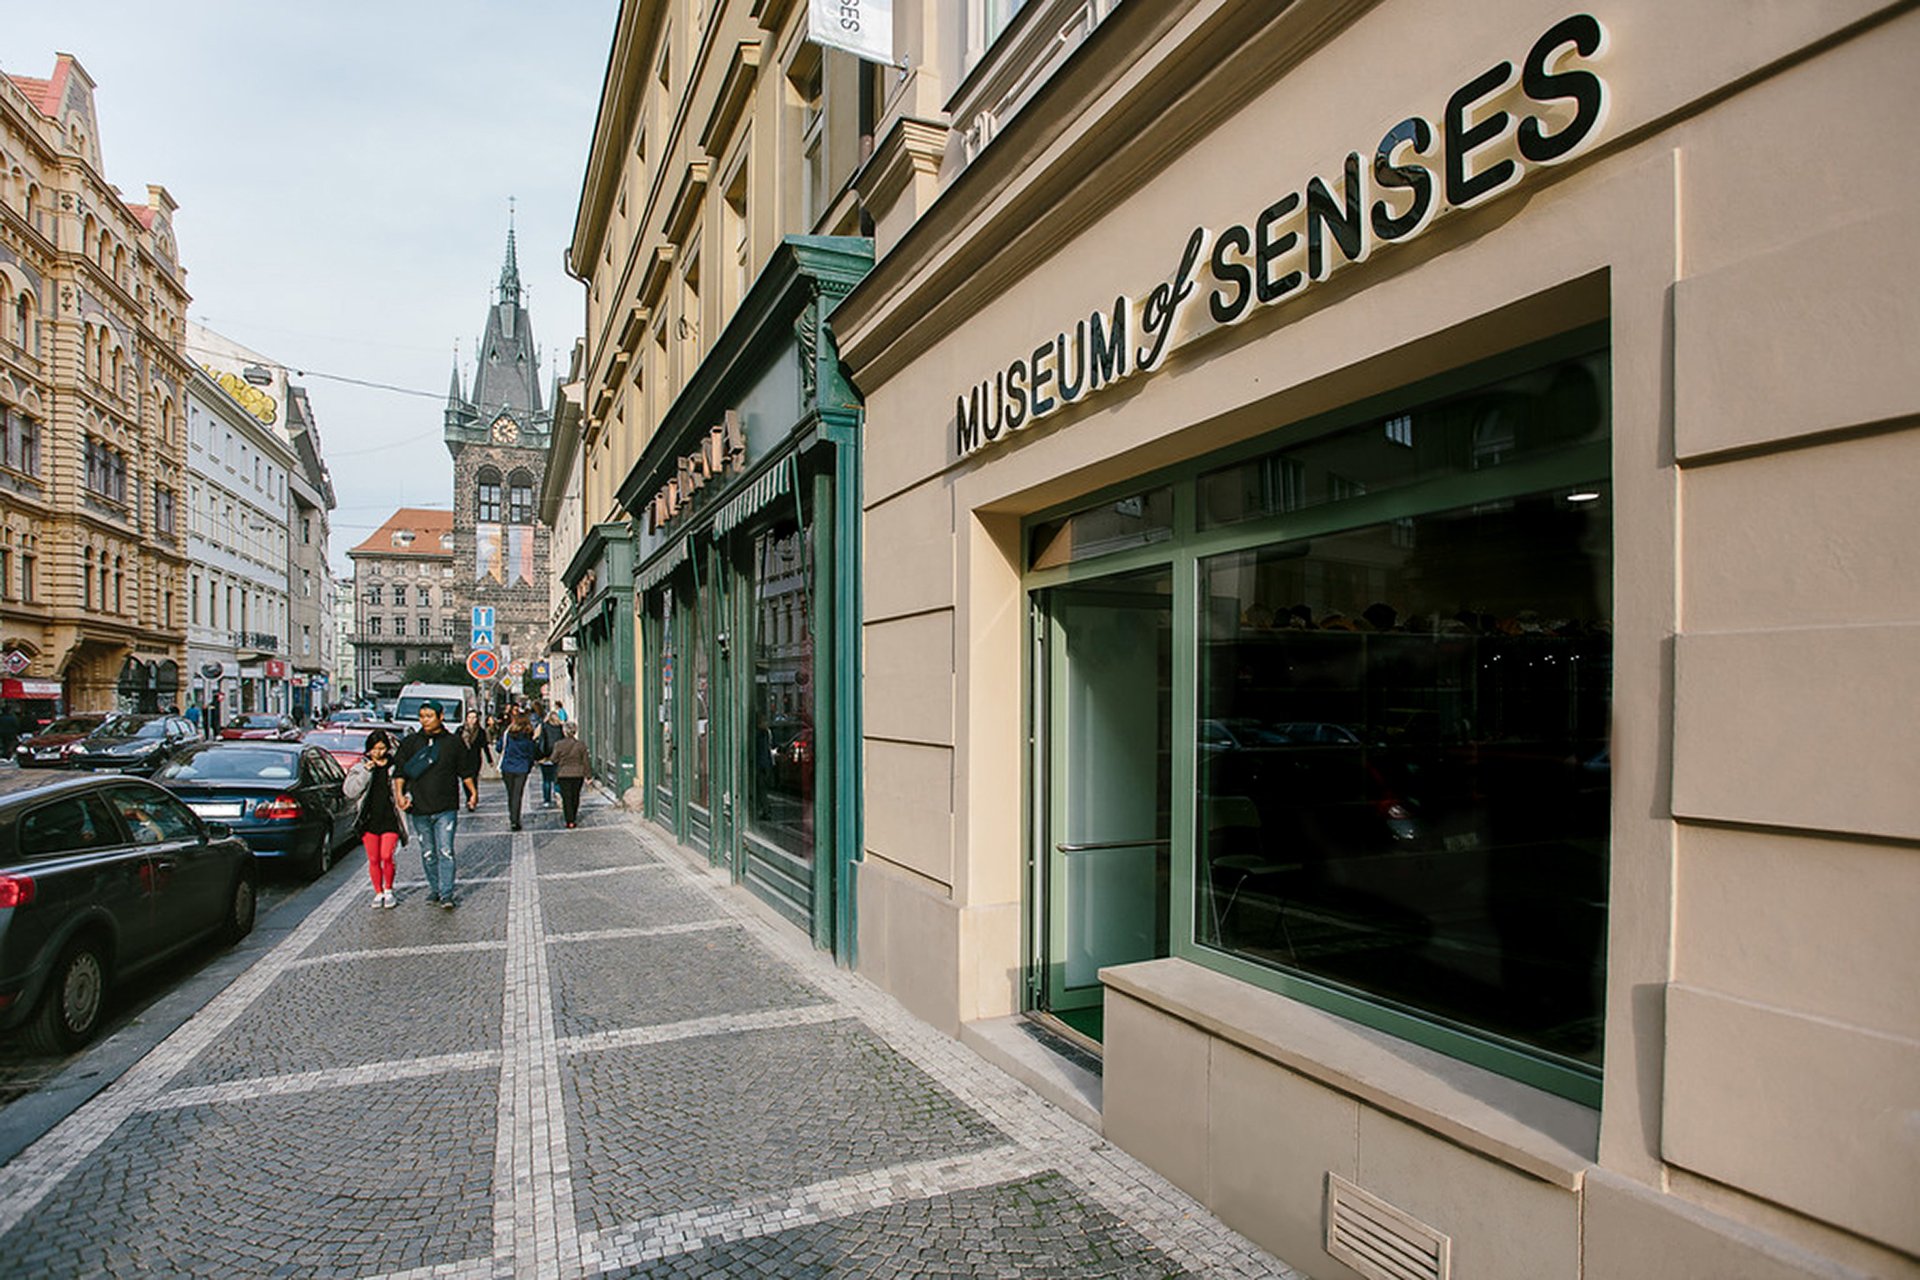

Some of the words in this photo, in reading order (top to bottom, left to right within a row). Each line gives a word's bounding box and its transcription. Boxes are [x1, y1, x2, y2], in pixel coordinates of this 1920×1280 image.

[957, 295, 1129, 456] MUSEUM
[1137, 227, 1205, 371] of
[1209, 13, 1604, 323] SENSES
